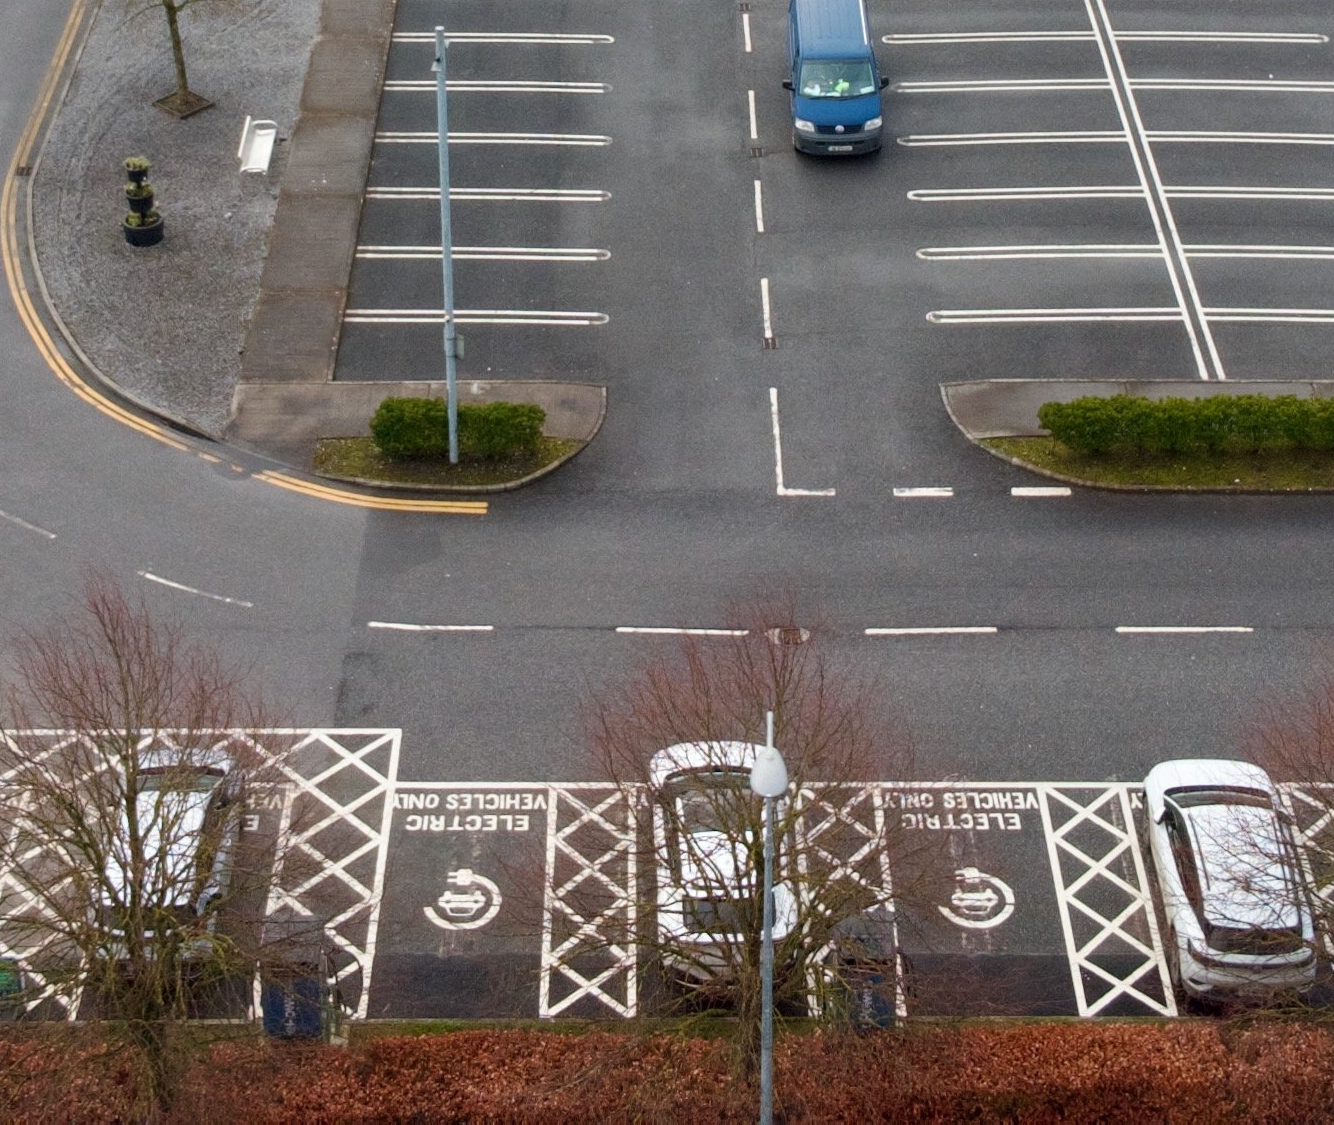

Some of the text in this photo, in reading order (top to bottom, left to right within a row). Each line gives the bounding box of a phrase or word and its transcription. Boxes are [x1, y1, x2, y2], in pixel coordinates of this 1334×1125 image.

[392, 793, 548, 811] VEHICLES ONLY
[882, 791, 1039, 809] VEHICLES ONLY
[404, 814, 530, 832] ELECTRIC
[901, 812, 1021, 830] ELECTRIC
